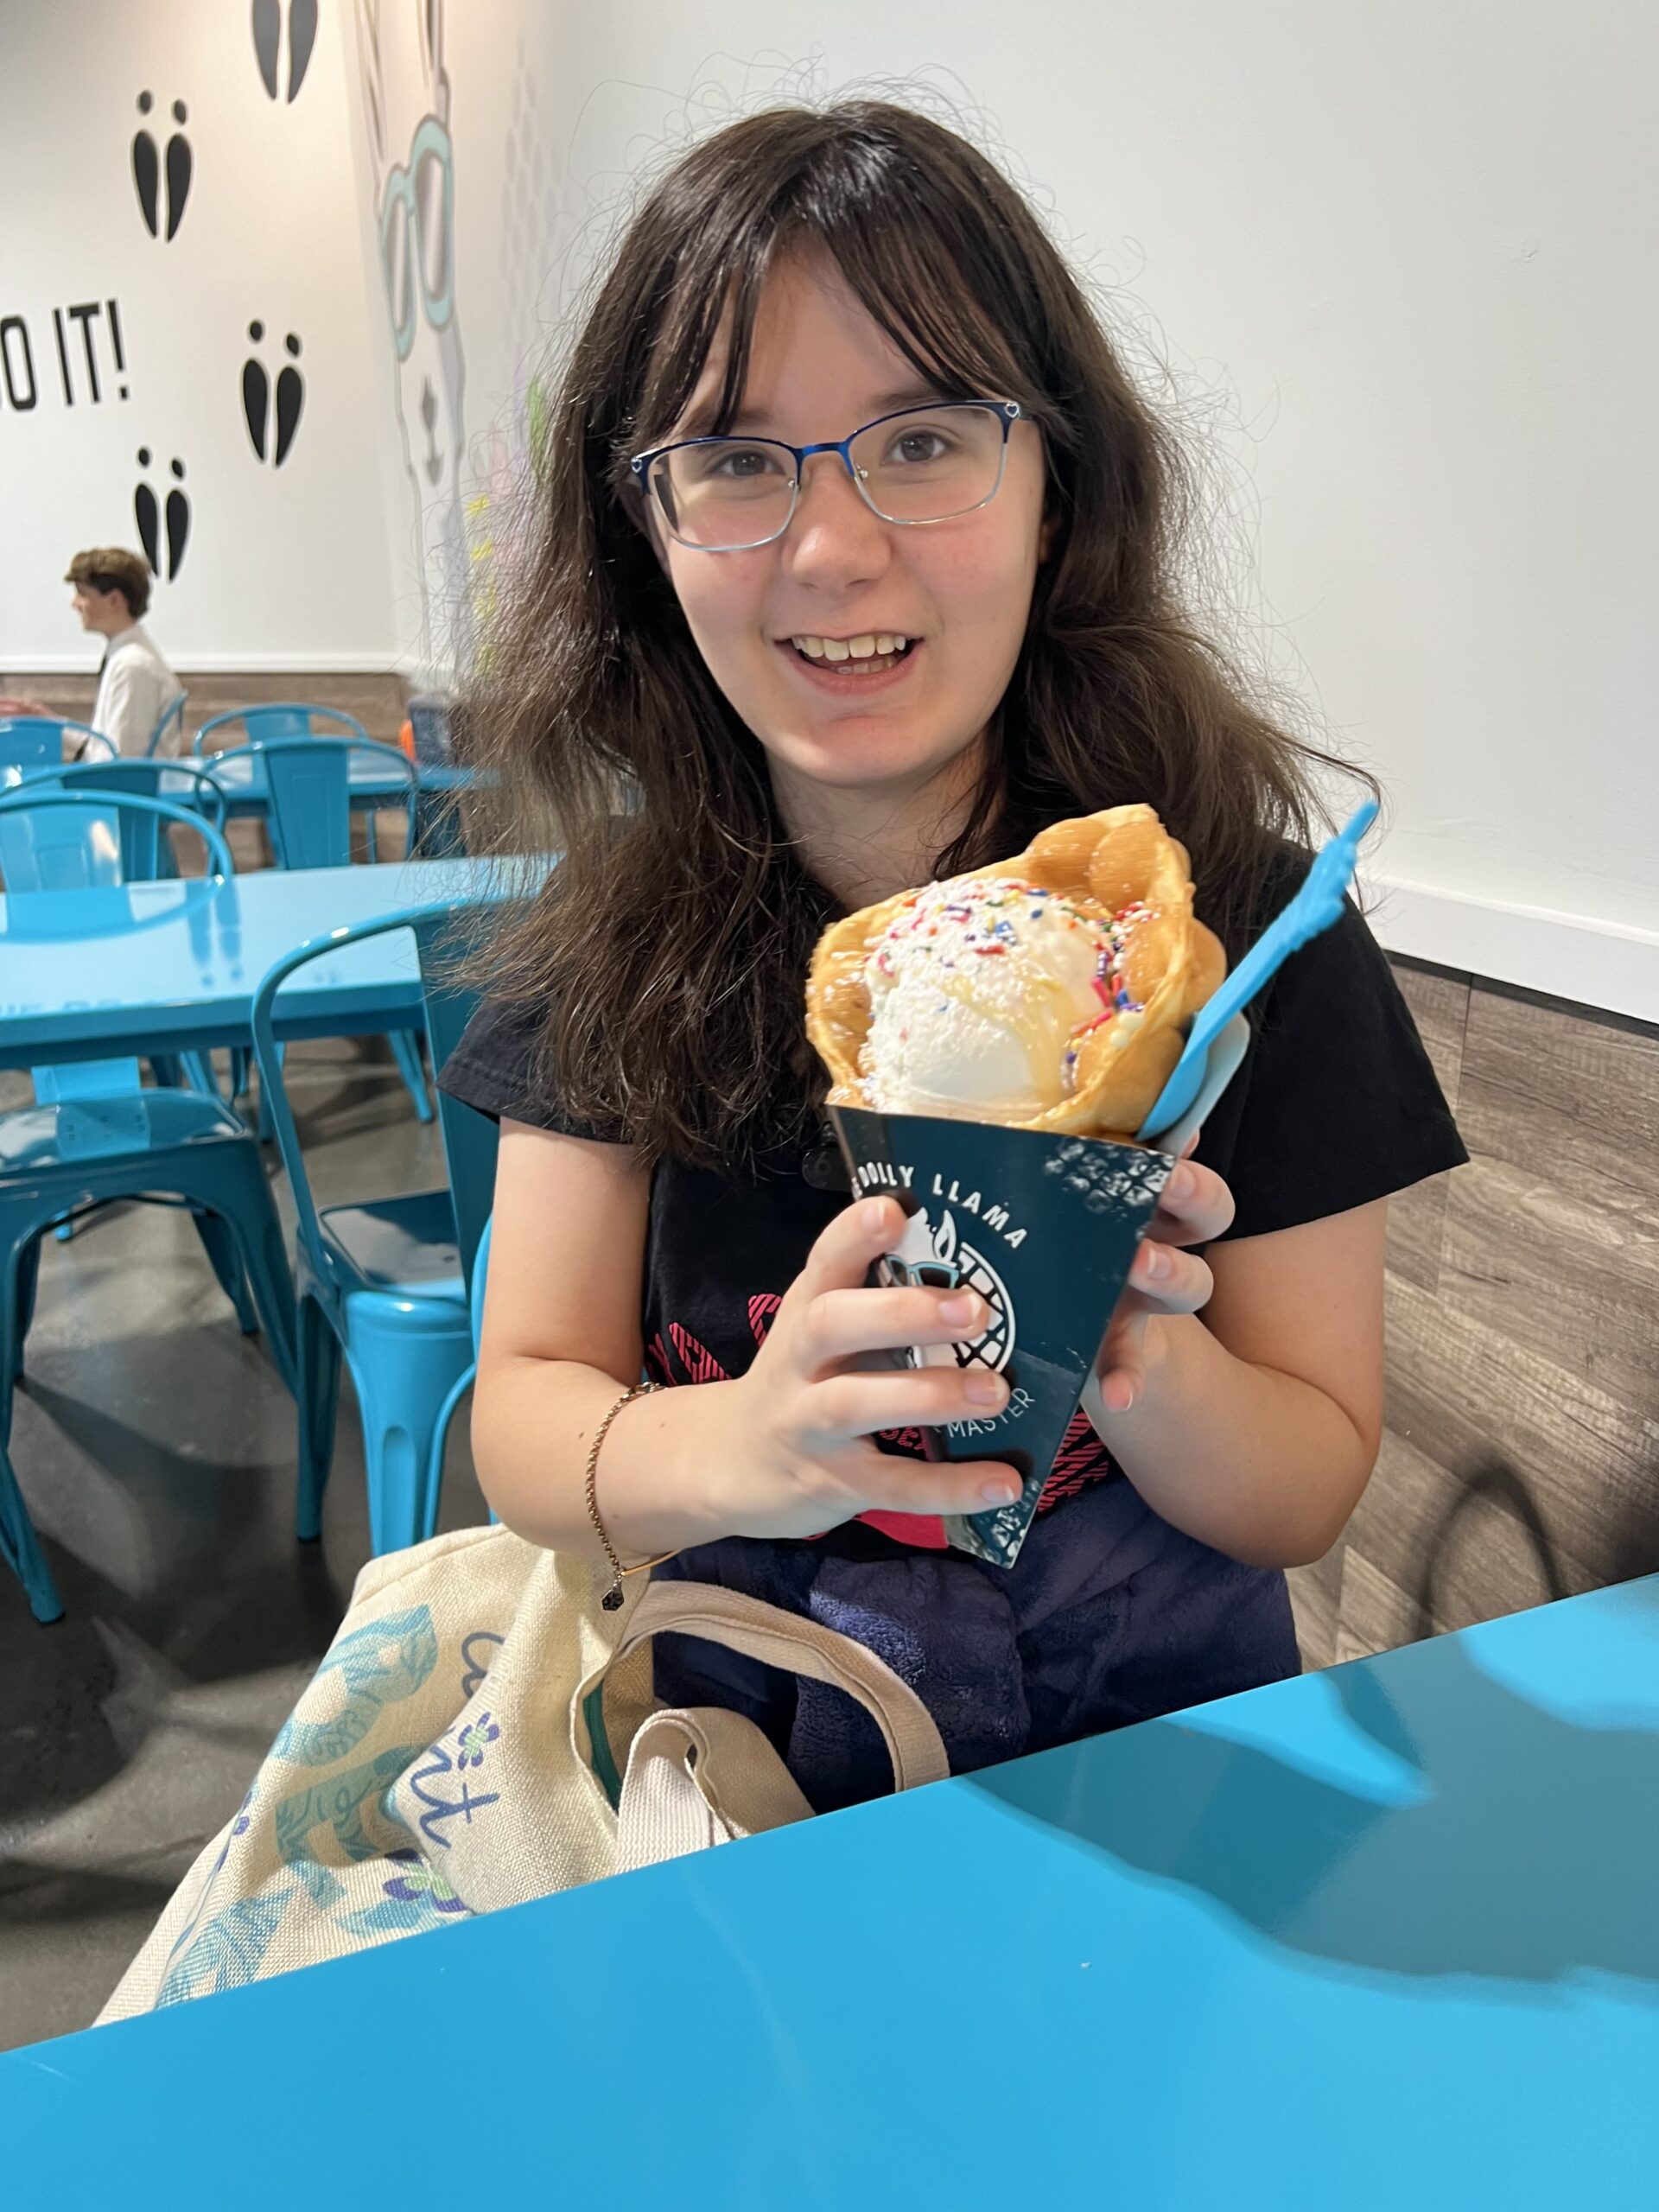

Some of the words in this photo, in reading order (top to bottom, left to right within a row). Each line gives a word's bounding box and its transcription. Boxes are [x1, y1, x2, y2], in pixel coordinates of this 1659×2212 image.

[0, 315, 37, 410] O
[53, 298, 129, 406] IT!
[857, 1161, 915, 1188] DOLLY
[932, 1173, 1027, 1249] LLAMA
